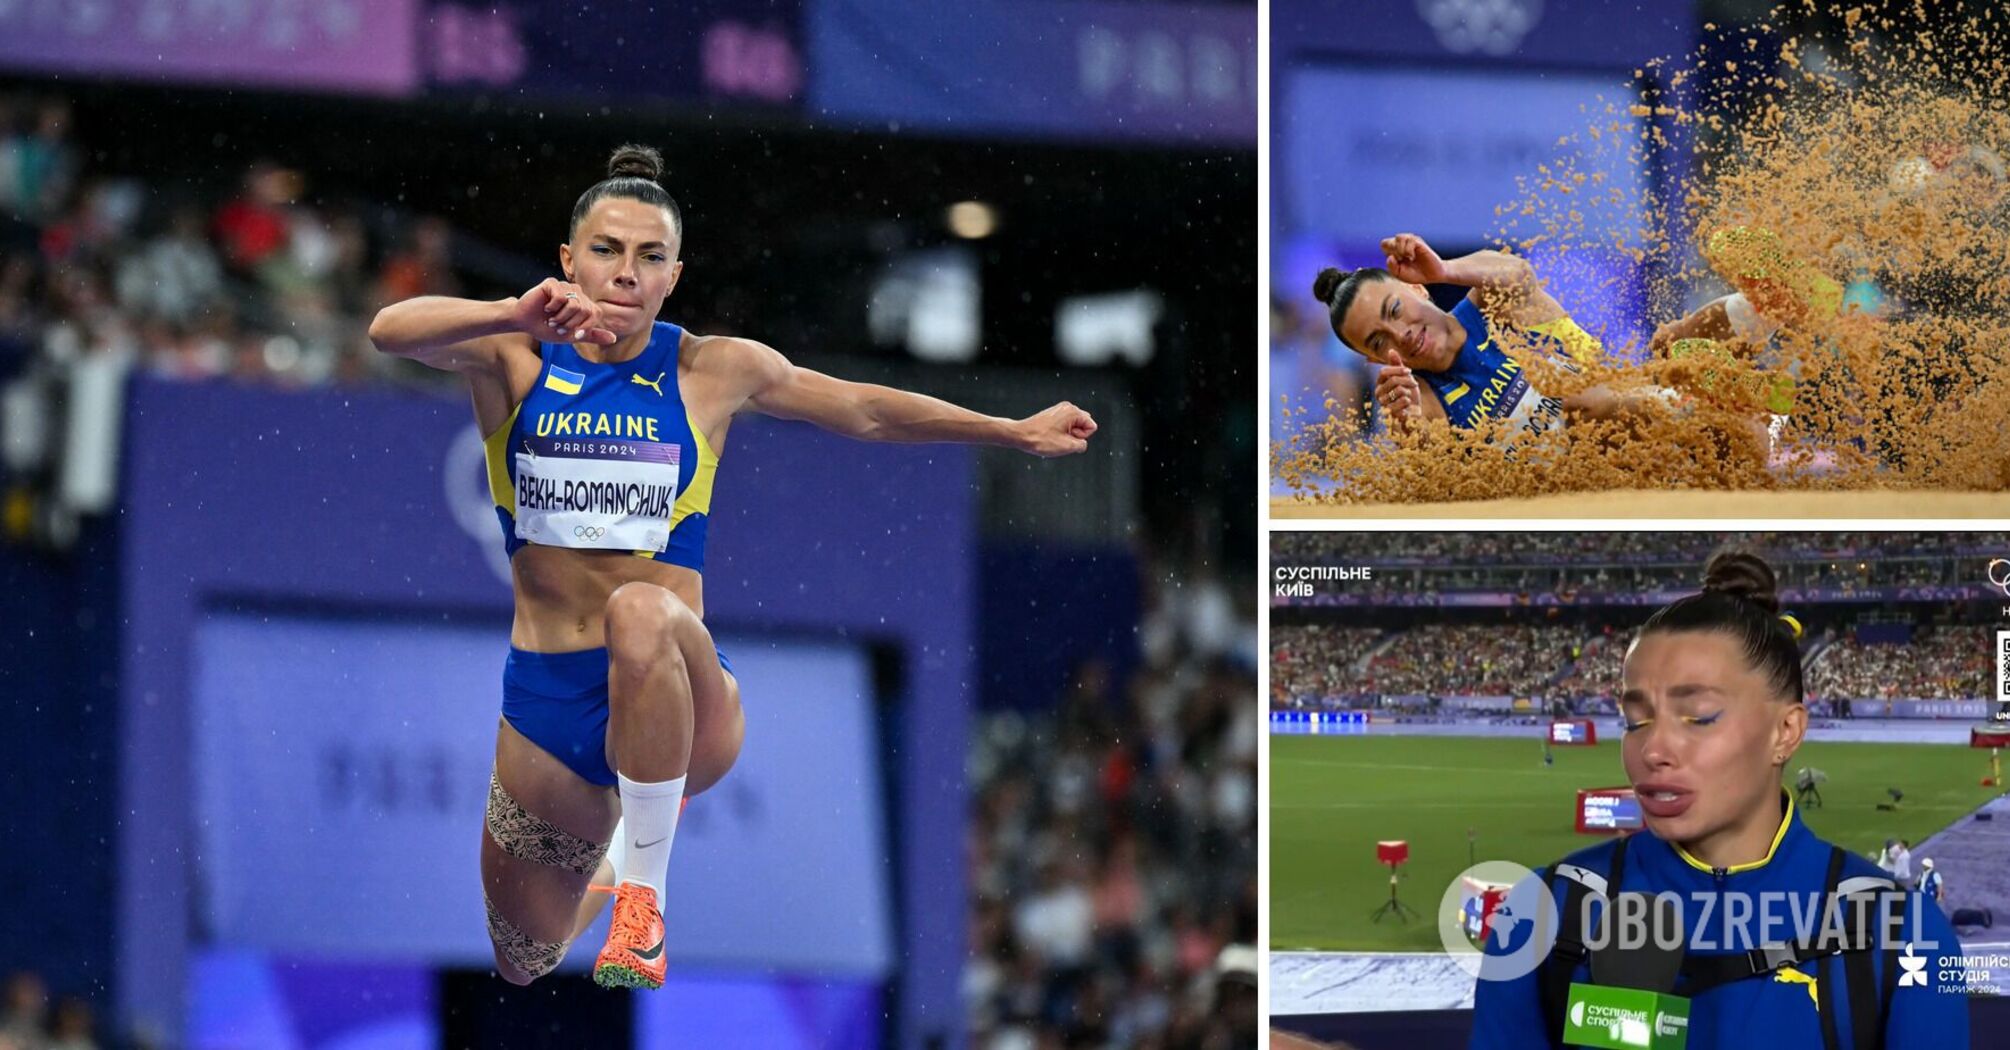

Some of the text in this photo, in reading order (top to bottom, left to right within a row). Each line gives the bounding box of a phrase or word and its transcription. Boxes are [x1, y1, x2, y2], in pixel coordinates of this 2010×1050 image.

[1467, 357, 1521, 431] UKRAIN
[536, 412, 660, 442] UKRAINE
[554, 442, 637, 456] PARIS 2024
[519, 474, 673, 519] BEKH-ROMANCHUK
